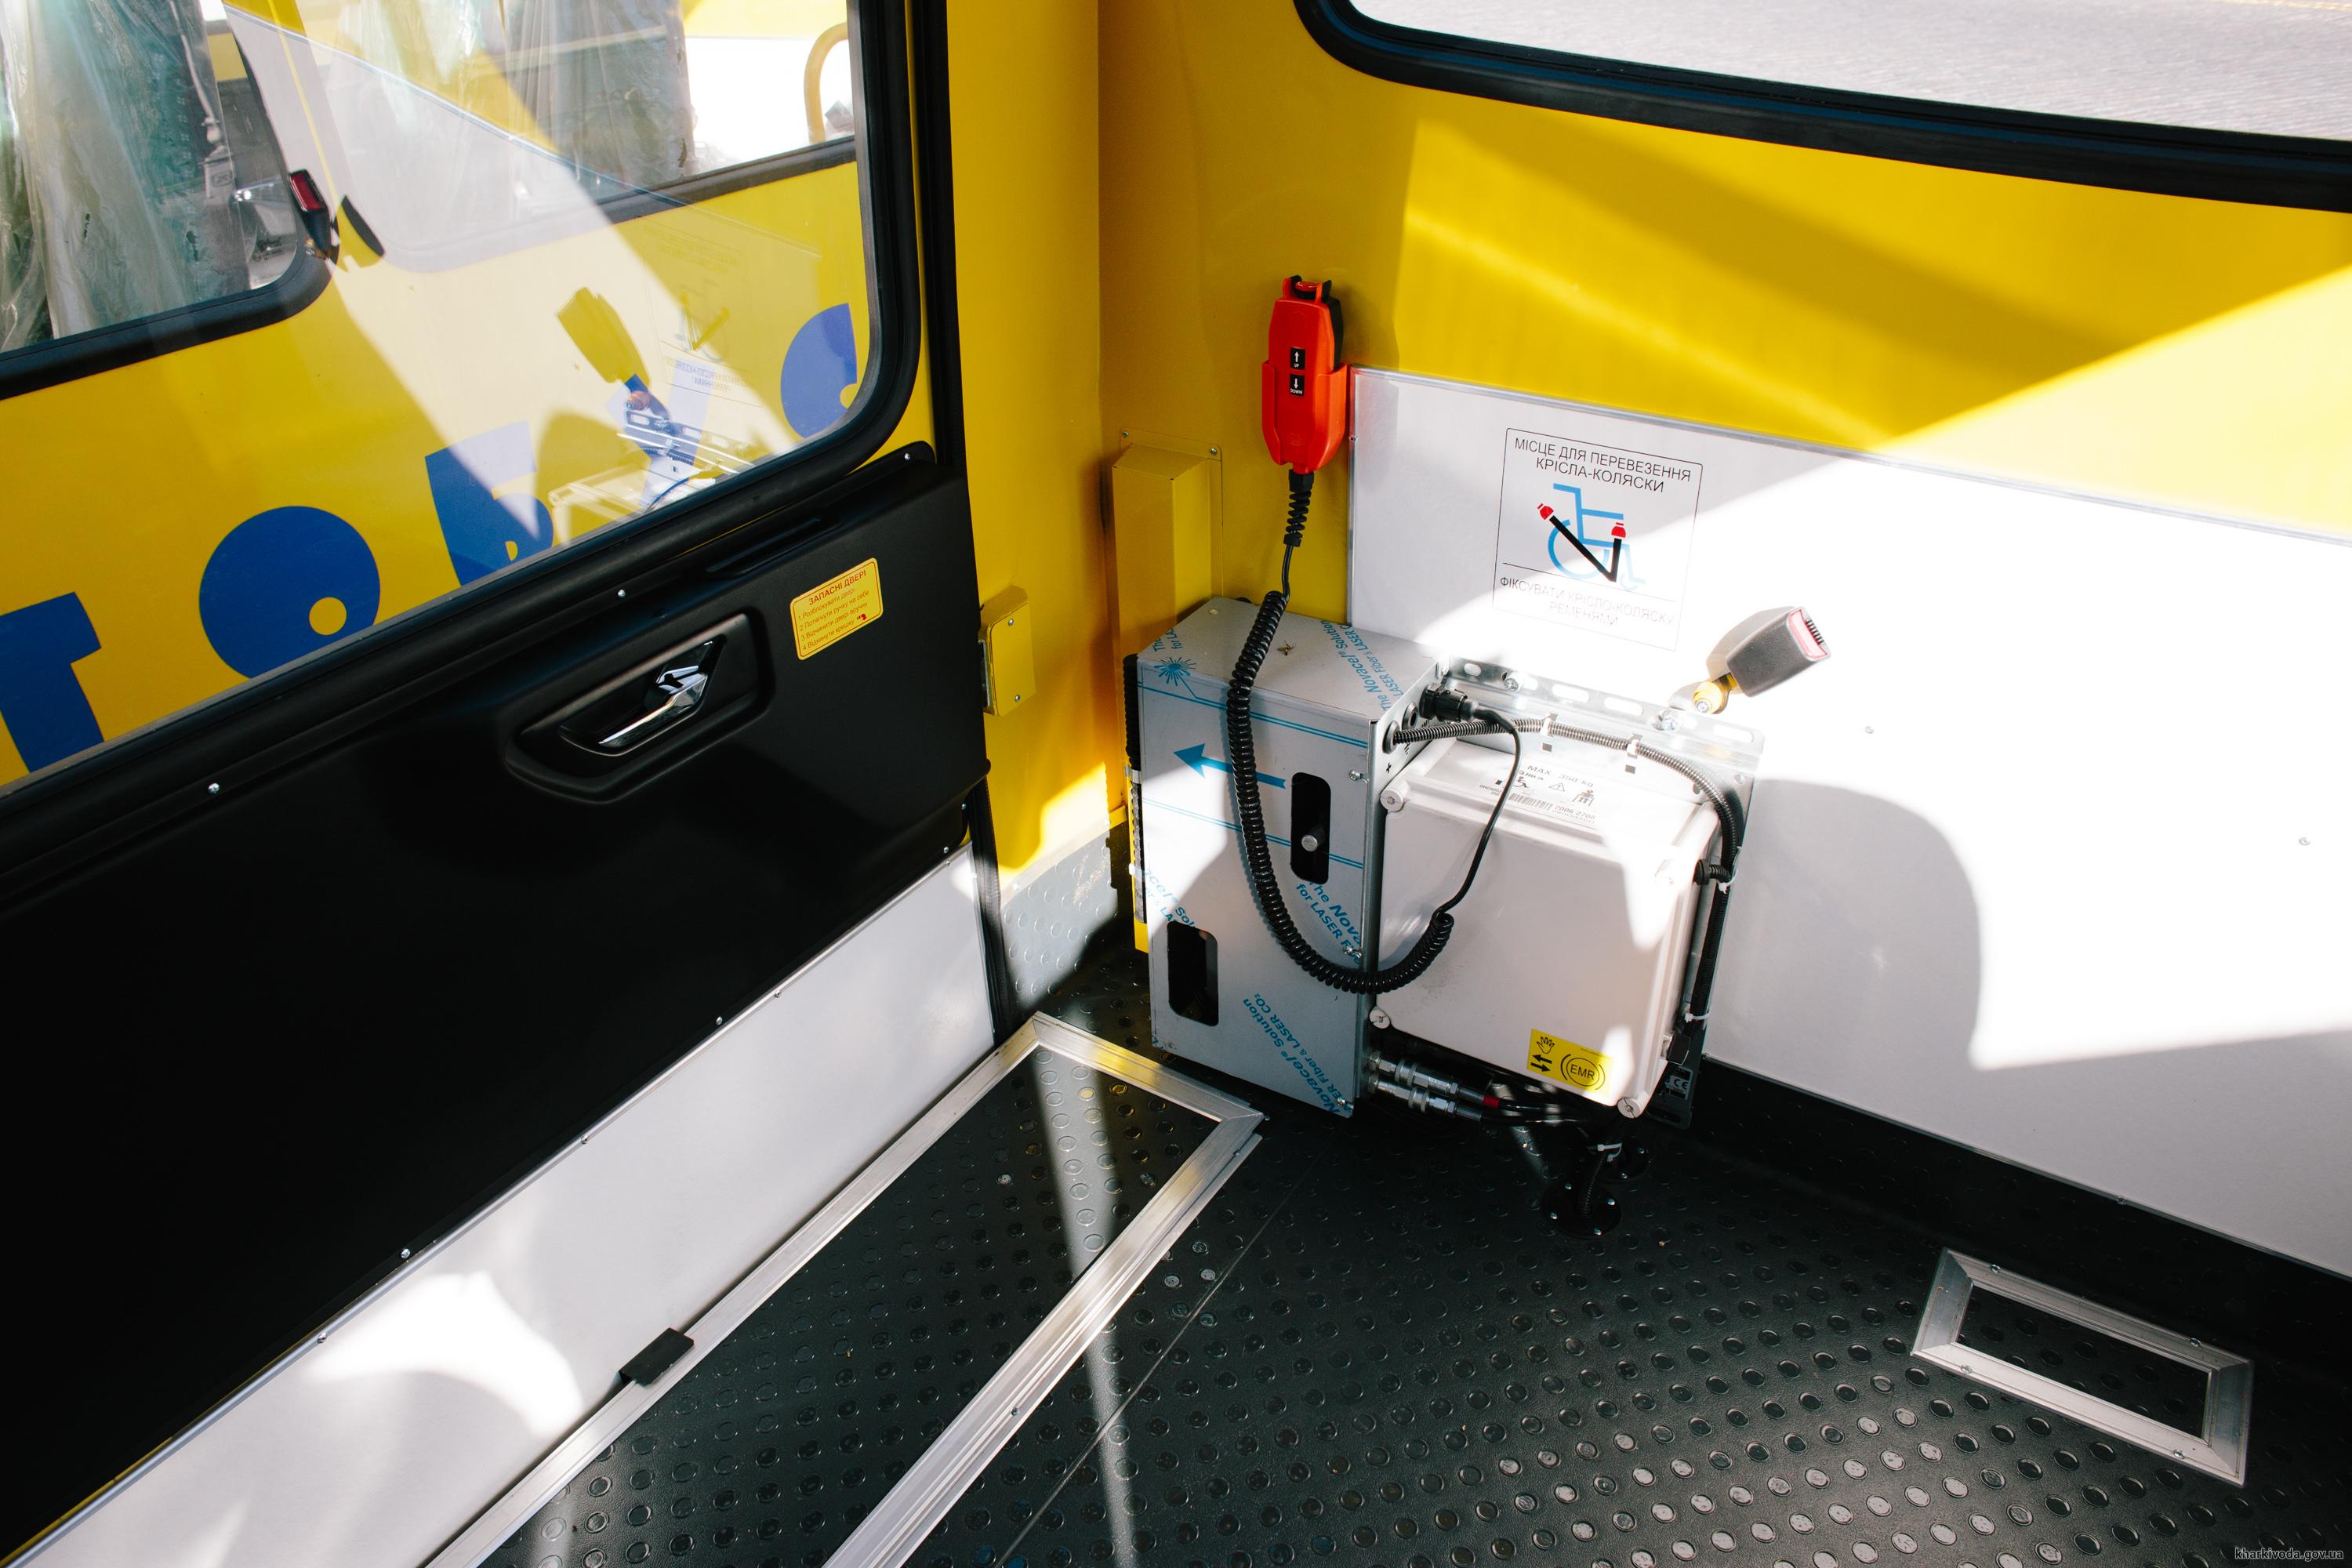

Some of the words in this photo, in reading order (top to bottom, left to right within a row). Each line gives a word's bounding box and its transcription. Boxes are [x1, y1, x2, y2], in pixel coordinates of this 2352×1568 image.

[1515, 437, 1555, 456] МІСЦЕ
[1559, 446, 1586, 462] ДЛЯ
[1590, 452, 1691, 481] ПЕРЕВЕЗЕННЯ
[1536, 457, 1664, 493] КРІСЛА-КОЛЯСКИ
[809, 583, 843, 605] ЗАПАСНІ
[844, 570, 866, 588] ДВЕРІ
[1344, 630, 1368, 651] LASER
[1379, 673, 1404, 698] LASER
[1296, 884, 1313, 901] for
[1310, 902, 1343, 939] LASER
[1243, 999, 1284, 1047] Solution
[1270, 1014, 1301, 1048] LASER
[1305, 1057, 1329, 1083] Fiber
[1570, 1064, 1595, 1080] EMR
